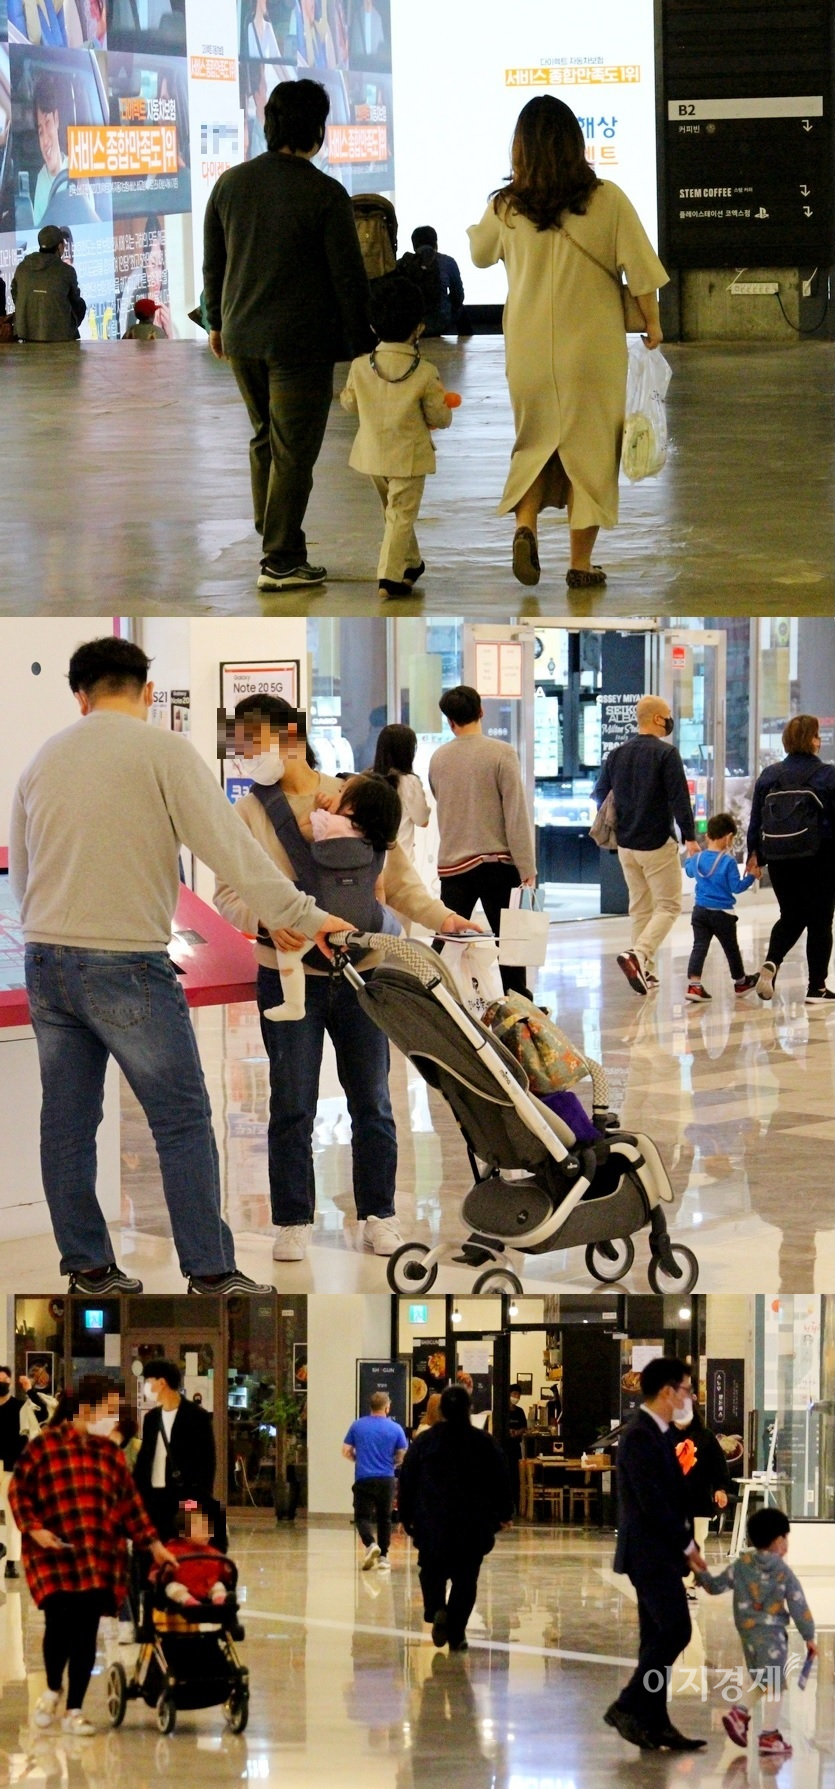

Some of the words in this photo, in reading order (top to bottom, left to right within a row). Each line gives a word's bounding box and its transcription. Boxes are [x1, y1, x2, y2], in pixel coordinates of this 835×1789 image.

[506, 68, 548, 85] 서비스
[678, 104, 696, 116] B2
[678, 125, 700, 134] 커피빈
[69, 130, 106, 172] 서비스
[679, 188, 702, 198] STEM
[703, 187, 732, 198] COFFEE
[679, 210, 724, 219] 플레이스테이션
[725, 209, 750, 218] 코엑스점
[233, 674, 251, 682] Galaxy
[233, 683, 257, 693] Note
[258, 683, 269, 693] 20
[270, 682, 284, 693] 5G
[152, 691, 168, 703] S21
[608, 714, 638, 723] ALBA
